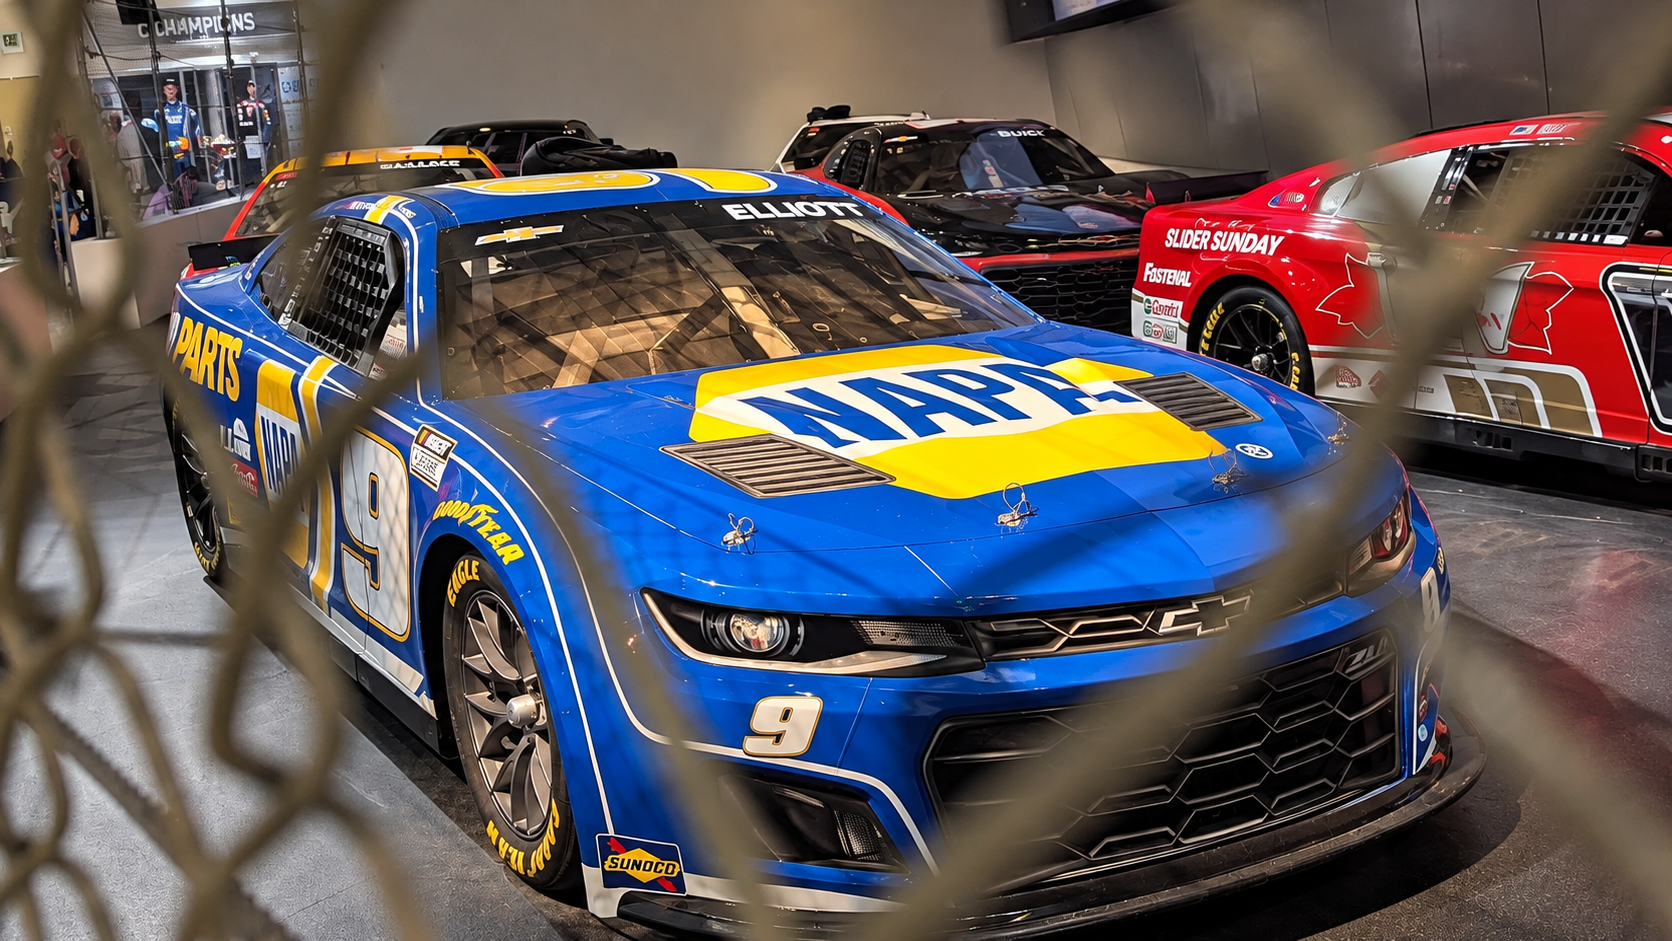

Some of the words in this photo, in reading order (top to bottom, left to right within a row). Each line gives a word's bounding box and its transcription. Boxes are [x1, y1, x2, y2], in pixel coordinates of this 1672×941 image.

[722, 201, 865, 221] ELLIOTT
[1164, 228, 1211, 250] SLIDER
[1210, 230, 1285, 256] SUNDAY
[172, 316, 243, 402] PARTS
[737, 363, 1143, 448] NAPA
[340, 424, 411, 643] 9
[432, 500, 525, 566] GOODYEAR
[447, 559, 480, 607] EAGLE
[743, 696, 823, 757] 9
[608, 856, 676, 876] SUNOCO
